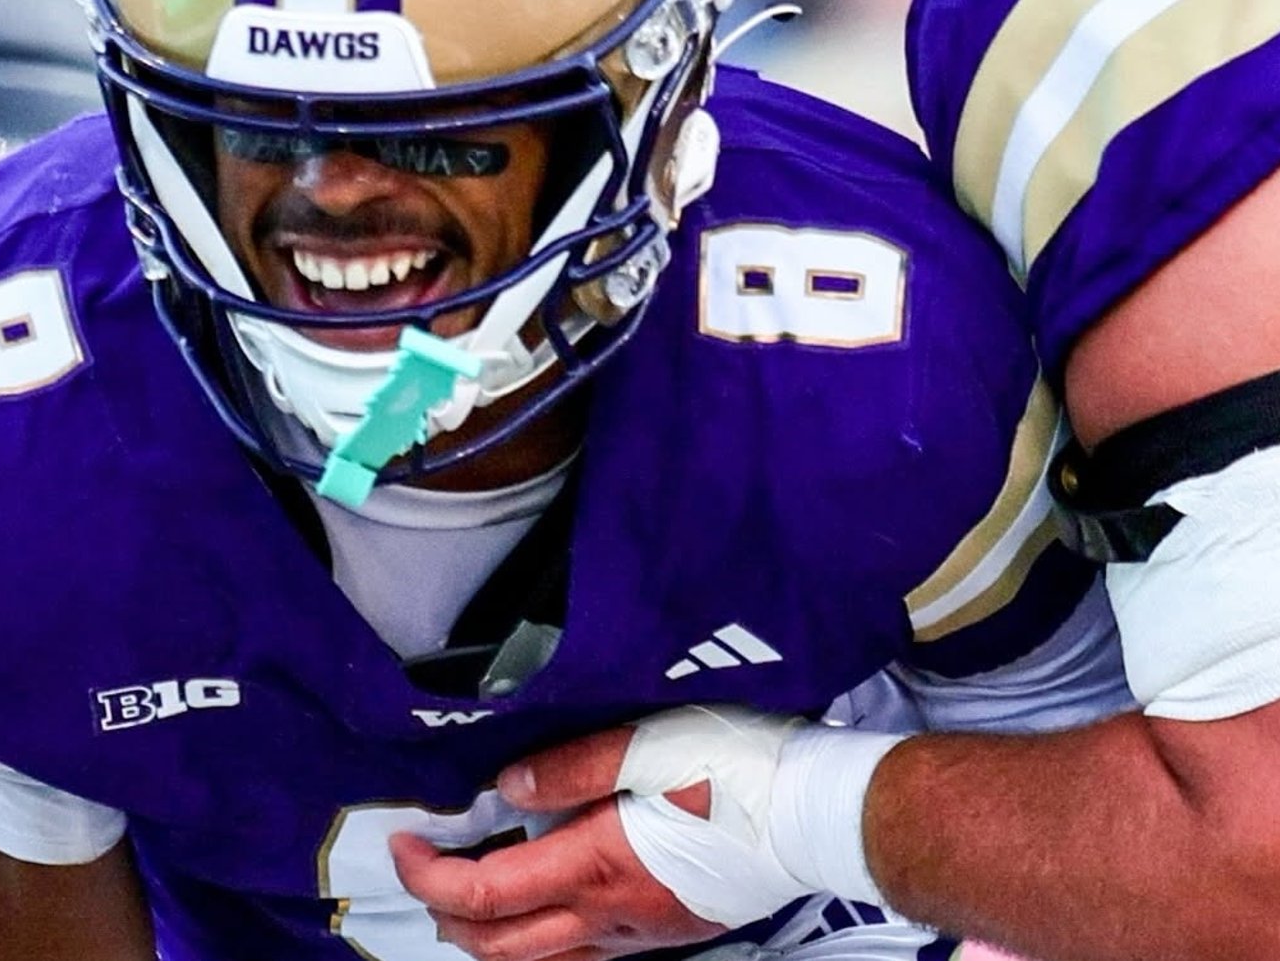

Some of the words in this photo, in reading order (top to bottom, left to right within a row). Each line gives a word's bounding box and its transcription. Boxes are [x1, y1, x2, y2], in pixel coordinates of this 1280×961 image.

[248, 25, 380, 60] DAWGS
[698, 222, 908, 349] 8
[410, 709, 494, 728] W
